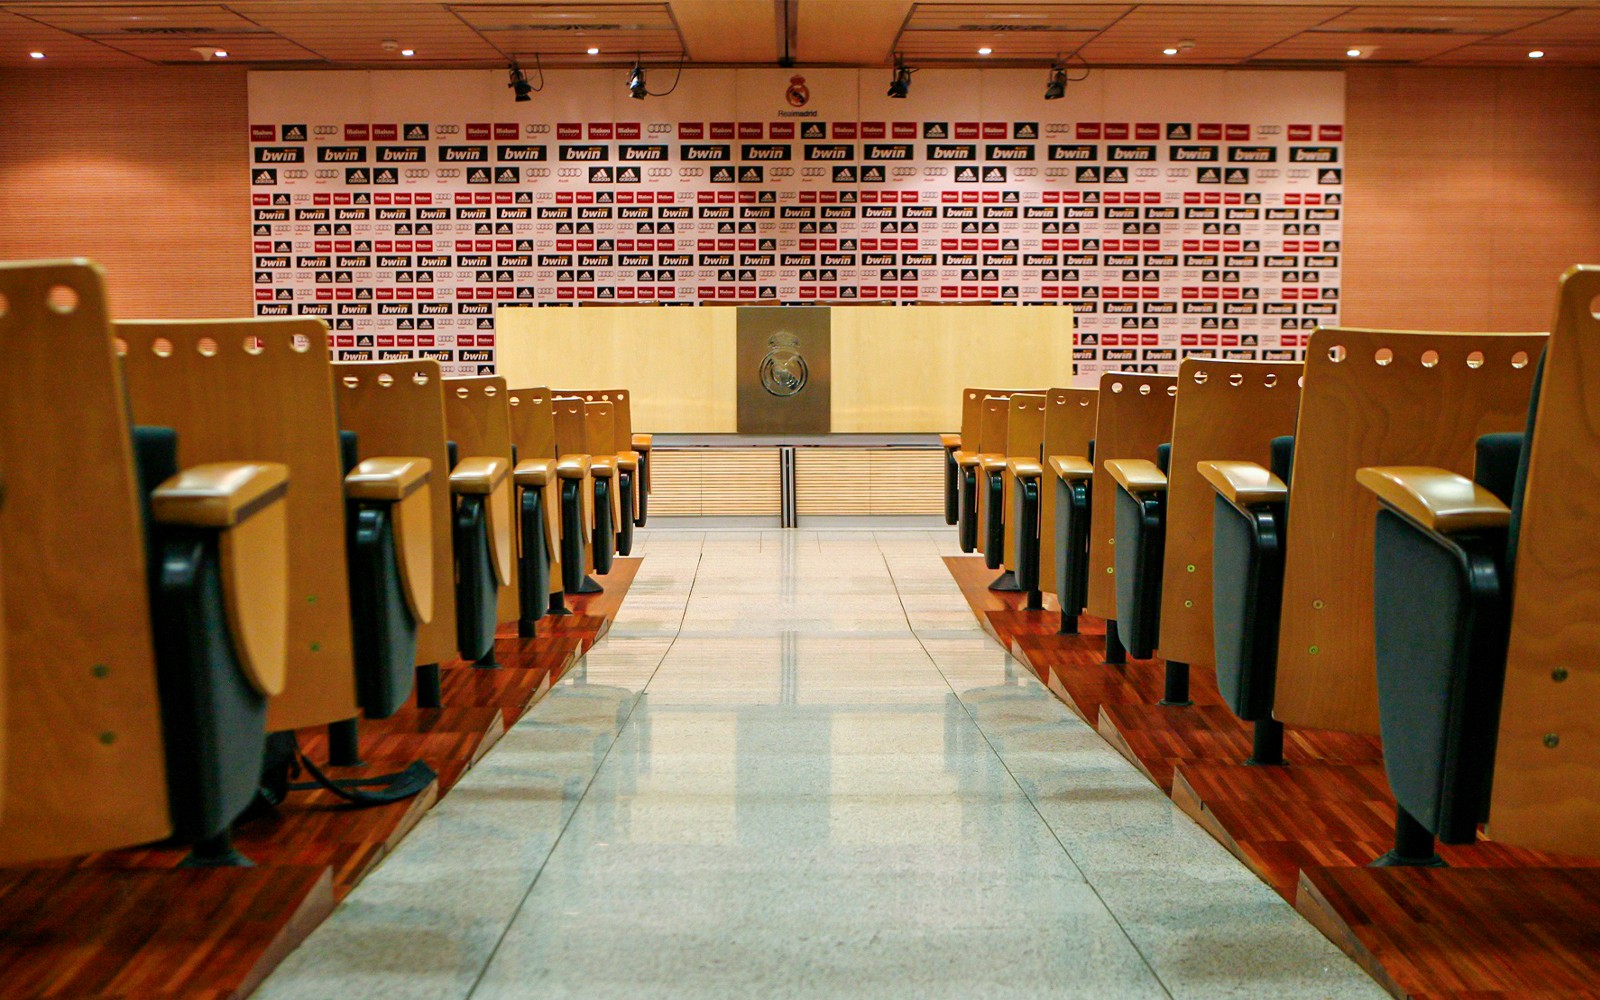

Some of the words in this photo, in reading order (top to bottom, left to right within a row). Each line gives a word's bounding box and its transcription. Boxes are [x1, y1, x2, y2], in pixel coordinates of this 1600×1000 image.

[262, 150, 296, 161] bwin
[325, 149, 358, 160] bwin
[384, 149, 417, 160] bwin
[446, 148, 480, 160] bwin
[505, 148, 538, 159] bwin
[566, 148, 601, 159] bwin
[626, 147, 660, 159] bwin
[688, 147, 722, 159] bwin
[748, 147, 783, 158] bwin
[811, 147, 846, 158] bwin
[871, 147, 905, 158] bwin
[933, 147, 968, 158] bwin
[992, 147, 1027, 159] bwin
[1055, 147, 1089, 159] bwin
[1114, 148, 1149, 159] bwin
[1176, 148, 1210, 159] bwin
[259, 211, 285, 219] bwin
[299, 210, 325, 219] bwin
[339, 210, 365, 219] bwin
[380, 210, 406, 218] bwin
[420, 210, 446, 218] bwin
[461, 209, 486, 218] bwin
[501, 209, 527, 218] bwin
[541, 209, 567, 218] bwin
[582, 209, 607, 218] bwin
[622, 209, 648, 217] bwin
[663, 209, 688, 217] bwin
[703, 208, 729, 217] bwin
[744, 208, 769, 217] bwin
[785, 208, 810, 217] bwin
[825, 208, 851, 217] bwin
[866, 208, 892, 216] bwin
[906, 208, 932, 216] bwin
[947, 208, 973, 217] bwin
[987, 208, 1013, 217] bwin
[1027, 208, 1053, 217] bwin
[1068, 208, 1094, 217] bwin
[1108, 209, 1134, 217] bwin
[1148, 209, 1174, 218] bwin
[260, 258, 286, 267] bwin
[301, 258, 326, 266] bwin
[341, 258, 366, 266] bwin
[381, 257, 407, 266] bwin
[421, 257, 447, 266] bwin
[461, 257, 486, 266] bwin
[502, 257, 527, 265] bwin
[542, 257, 567, 265] bwin
[582, 256, 608, 265] bwin
[623, 256, 648, 265] bwin
[663, 256, 688, 265] bwin
[703, 256, 729, 264] bwin
[744, 256, 770, 264] bwin
[785, 256, 810, 264] bwin
[825, 256, 851, 264] bwin
[866, 255, 891, 264] bwin
[906, 255, 932, 264] bwin
[946, 256, 972, 264] bwin
[987, 256, 1013, 264] bwin
[1027, 256, 1053, 264] bwin
[1067, 256, 1093, 264] bwin
[1108, 256, 1133, 265] bwin
[1148, 256, 1173, 265] bwin
[262, 305, 287, 314] bwin
[302, 305, 327, 314] bwin
[342, 305, 367, 314] bwin
[382, 305, 407, 313] bwin
[422, 304, 447, 313] bwin
[462, 304, 487, 313] bwin
[1107, 303, 1133, 312] bwin
[1147, 304, 1173, 312] bwin
[463, 352, 489, 361] bwin
[1107, 351, 1133, 360] bwin
[1147, 351, 1172, 360] bwin
